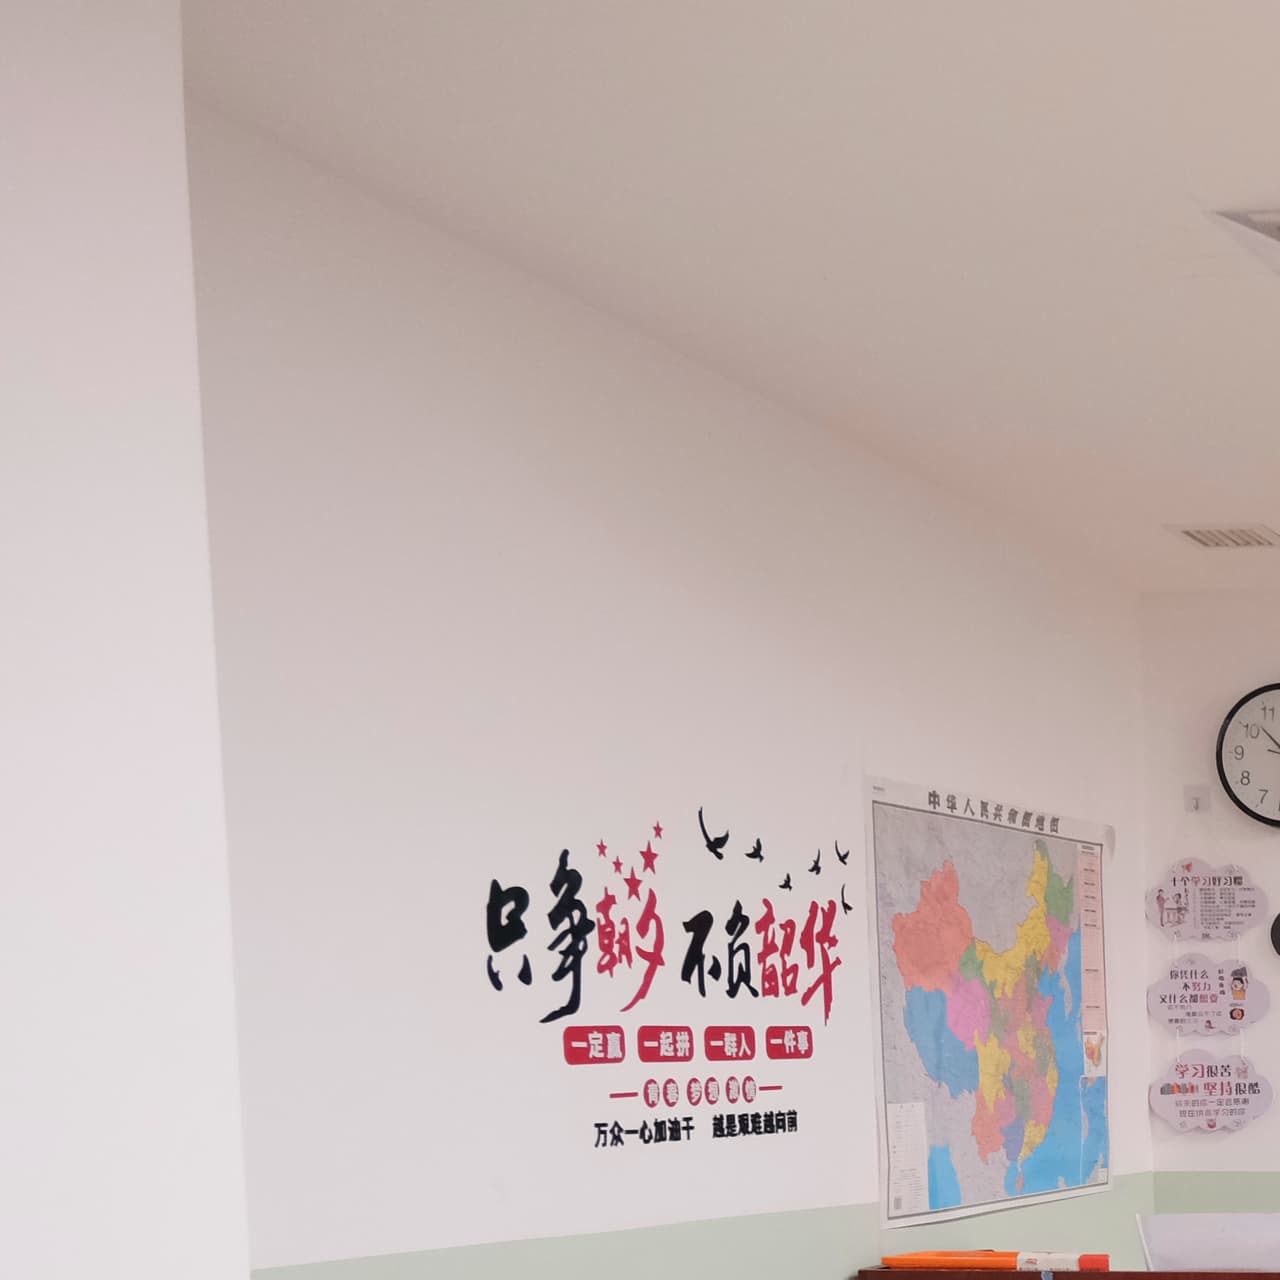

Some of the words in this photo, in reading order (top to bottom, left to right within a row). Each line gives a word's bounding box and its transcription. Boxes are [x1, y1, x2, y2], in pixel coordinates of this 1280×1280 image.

[1260, 705, 1276, 721] 11
[1242, 722, 1261, 740] 10
[1233, 744, 1245, 761] 9
[1240, 770, 1251, 786] 8
[1258, 788, 1269, 805] 7
[928, 790, 1060, 833] 中华人民共和国地图
[486, 848, 665, 1024] 只争朝夕
[681, 897, 842, 1027] 不负韶华
[1182, 982, 1211, 992] 不努力
[571, 1031, 623, 1059] 一定赢
[643, 1031, 690, 1057] 一起拼
[710, 1031, 752, 1057] 一群人
[769, 1029, 809, 1055] 一件事
[1175, 1064, 1232, 1079] 学习很苦
[1203, 1081, 1261, 1096] 坚持很酷
[594, 1116, 695, 1148] 万众一心加油干
[711, 1109, 798, 1138] 越是艰难越向前
